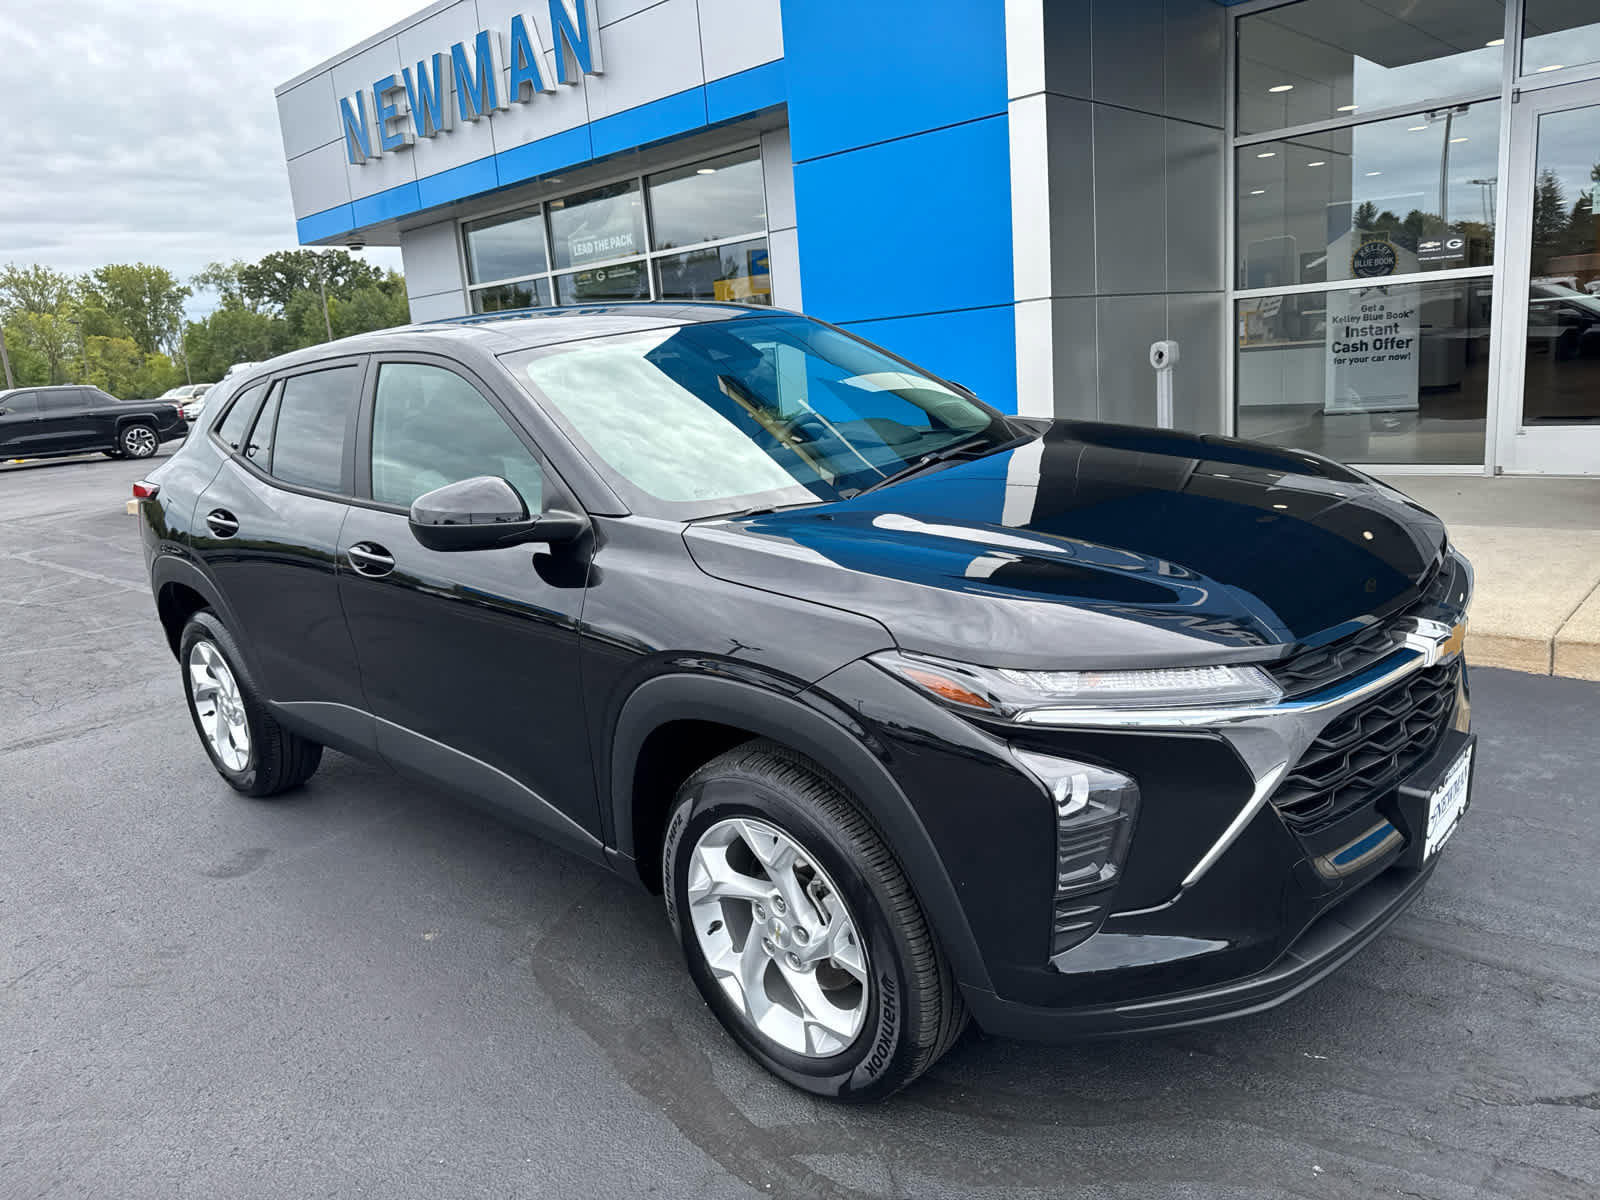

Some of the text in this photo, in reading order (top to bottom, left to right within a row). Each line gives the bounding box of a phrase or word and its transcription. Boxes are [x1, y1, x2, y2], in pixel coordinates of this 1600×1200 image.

[339, 0, 603, 165] NEWMAN
[573, 241, 593, 256] LEAD
[593, 238, 610, 251] THE
[610, 232, 632, 249] PACK
[1353, 256, 1394, 268] BLUE BOOK
[1361, 304, 1385, 313] Get a
[1332, 315, 1360, 324] Kelley
[1363, 313, 1384, 321] Blue
[1345, 322, 1400, 338] Instant
[1332, 337, 1413, 353] Cash Offer
[1334, 352, 1411, 365] for your car now!
